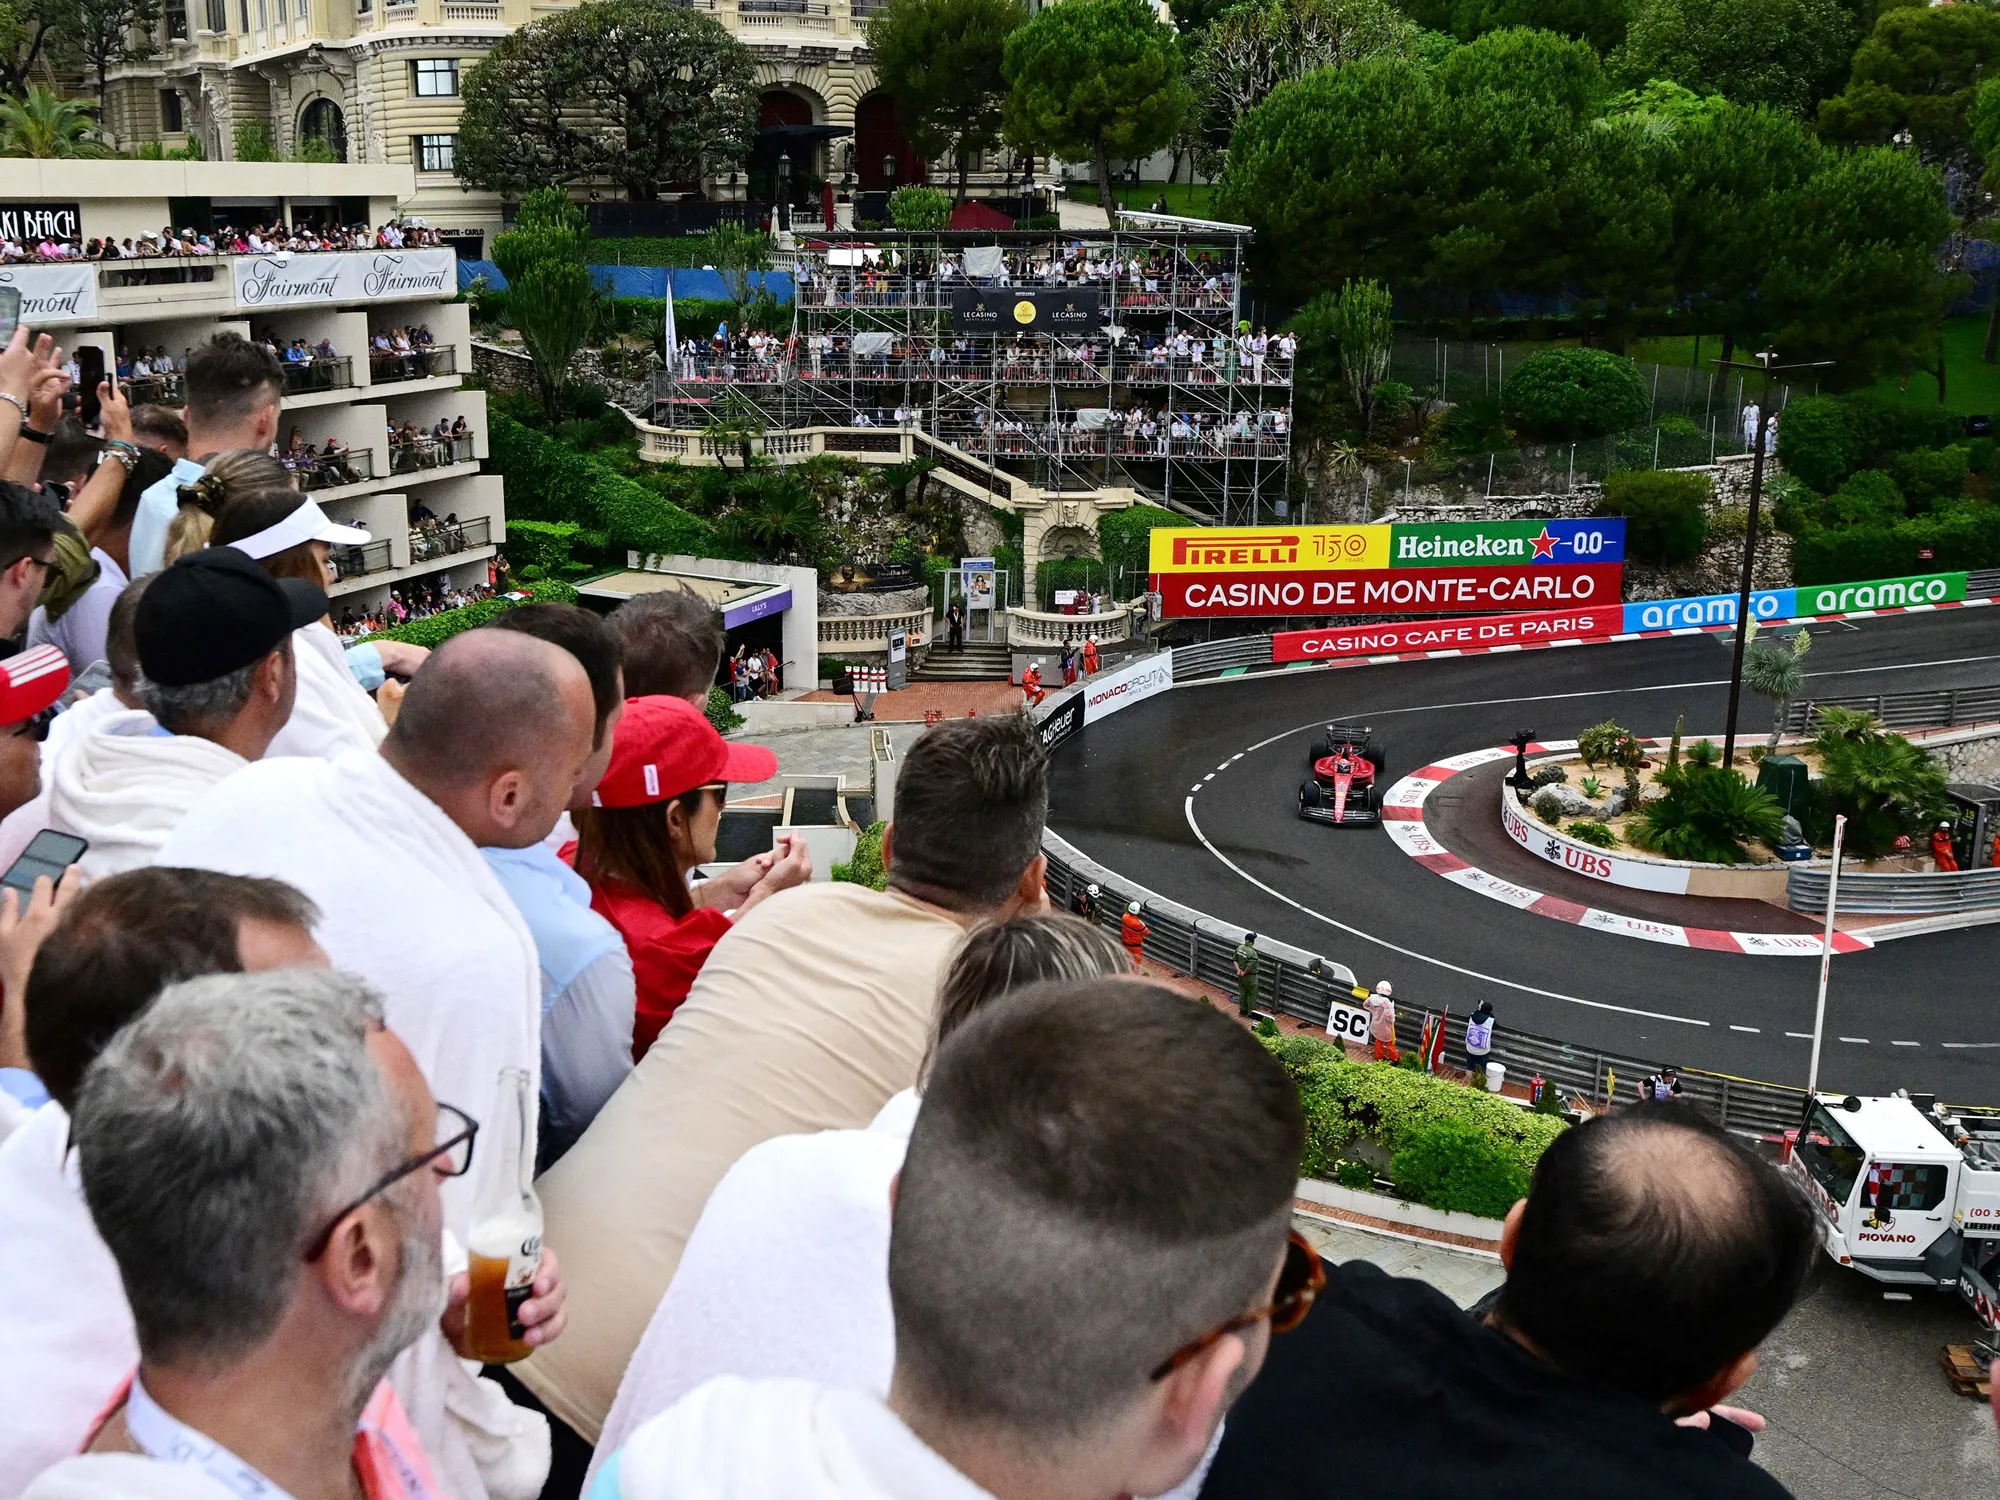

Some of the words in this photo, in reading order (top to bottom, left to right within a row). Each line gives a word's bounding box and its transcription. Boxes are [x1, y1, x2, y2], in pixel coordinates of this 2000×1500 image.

[0, 211, 19, 239] KI
[23, 211, 76, 239] BEACH
[464, 228, 484, 236] CARLO
[242, 259, 341, 304] Fairmont
[363, 254, 448, 297] Fairmont
[1172, 535, 1300, 565] PIRELLI
[1312, 534, 1367, 563] 150
[1397, 534, 1524, 559] Heineken
[1185, 582, 1304, 607] CASINO
[1313, 582, 1355, 605] DE
[1364, 575, 1595, 604] MONTE-CARLO
[1816, 579, 1947, 611] aramco
[1302, 633, 1398, 653] CASINO
[1405, 627, 1470, 645] CAFE
[1479, 623, 1514, 639] DE
[1520, 616, 1595, 635] PARIS
[1400, 789, 1417, 805] UBS
[1507, 812, 1529, 843] UBS
[1408, 833, 1435, 853] UBS
[1564, 847, 1612, 878] UBS
[1488, 881, 1531, 900] UBS
[1626, 920, 1675, 936] UBS
[1773, 938, 1820, 949] UBS
[1333, 1009, 1367, 1038] SC
[1858, 1233, 1916, 1243] PIOVANO
